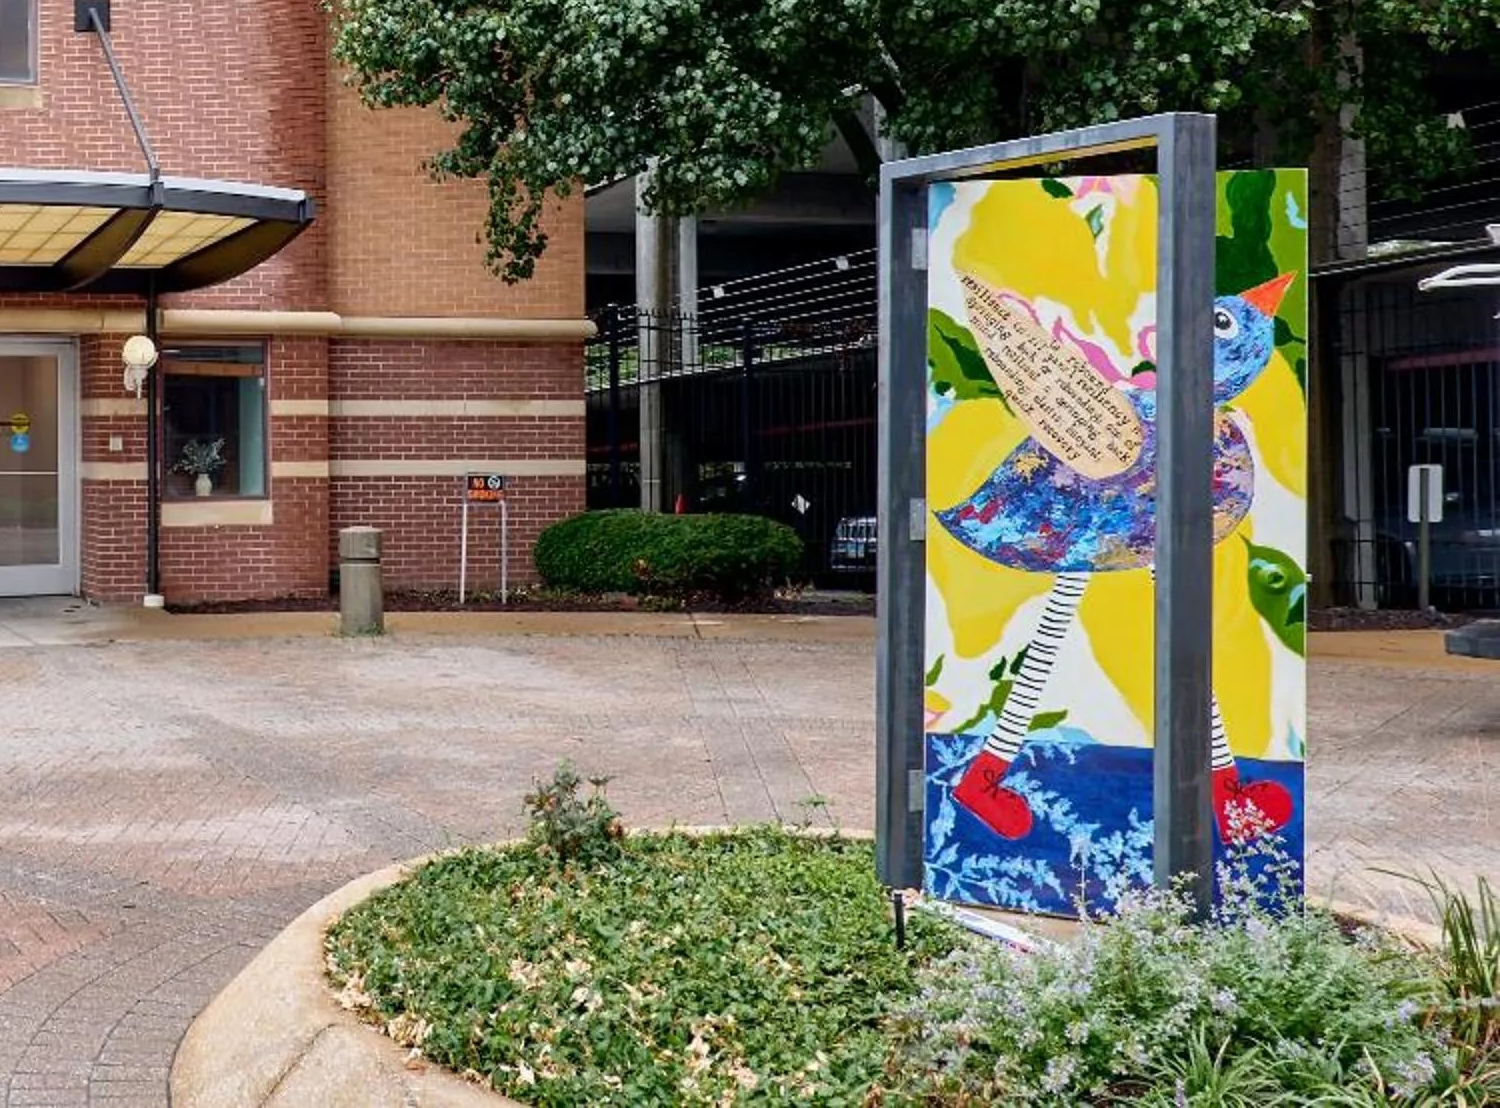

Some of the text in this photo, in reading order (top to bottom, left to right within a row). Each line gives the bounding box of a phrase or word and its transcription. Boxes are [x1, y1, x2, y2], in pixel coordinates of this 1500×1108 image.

[961, 275, 1009, 321] resilience
[965, 296, 1012, 341] springing
[1038, 419, 1080, 461] recovery
[1052, 395, 1100, 440] springing
